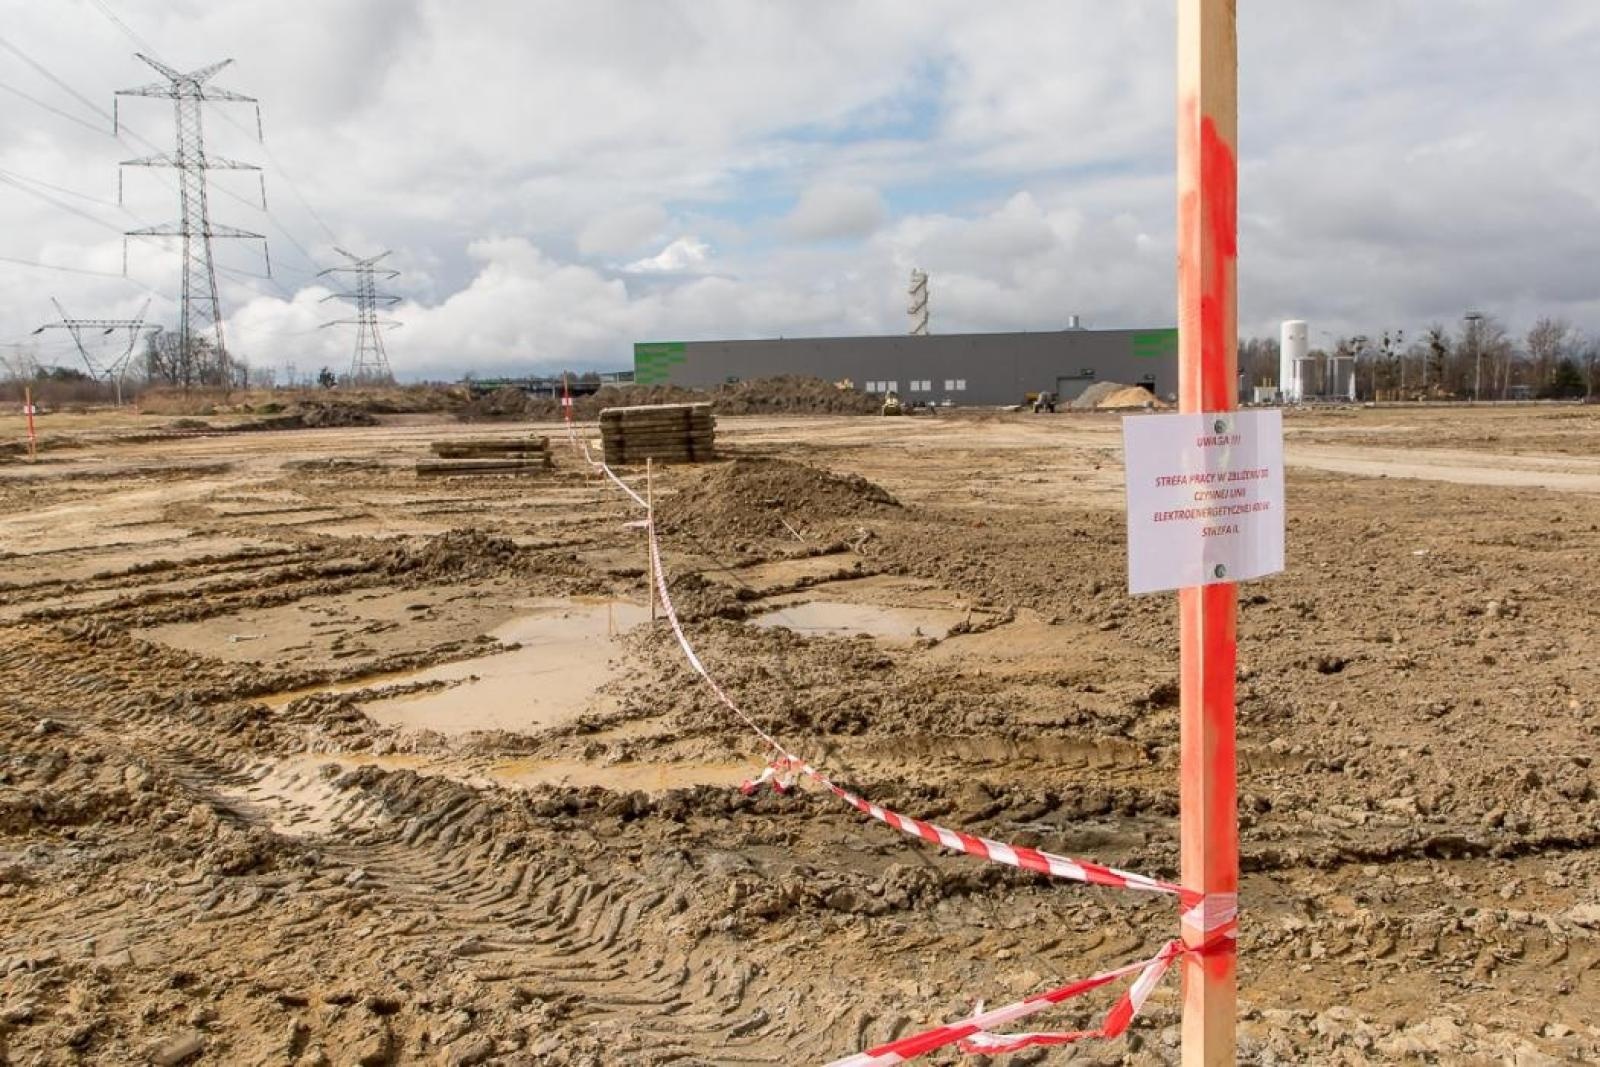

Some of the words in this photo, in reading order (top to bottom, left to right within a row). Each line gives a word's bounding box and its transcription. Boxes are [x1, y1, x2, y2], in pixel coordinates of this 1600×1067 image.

[1155, 475, 1187, 487] STREFA
[1189, 473, 1216, 484] PRACY
[1217, 471, 1226, 482] W
